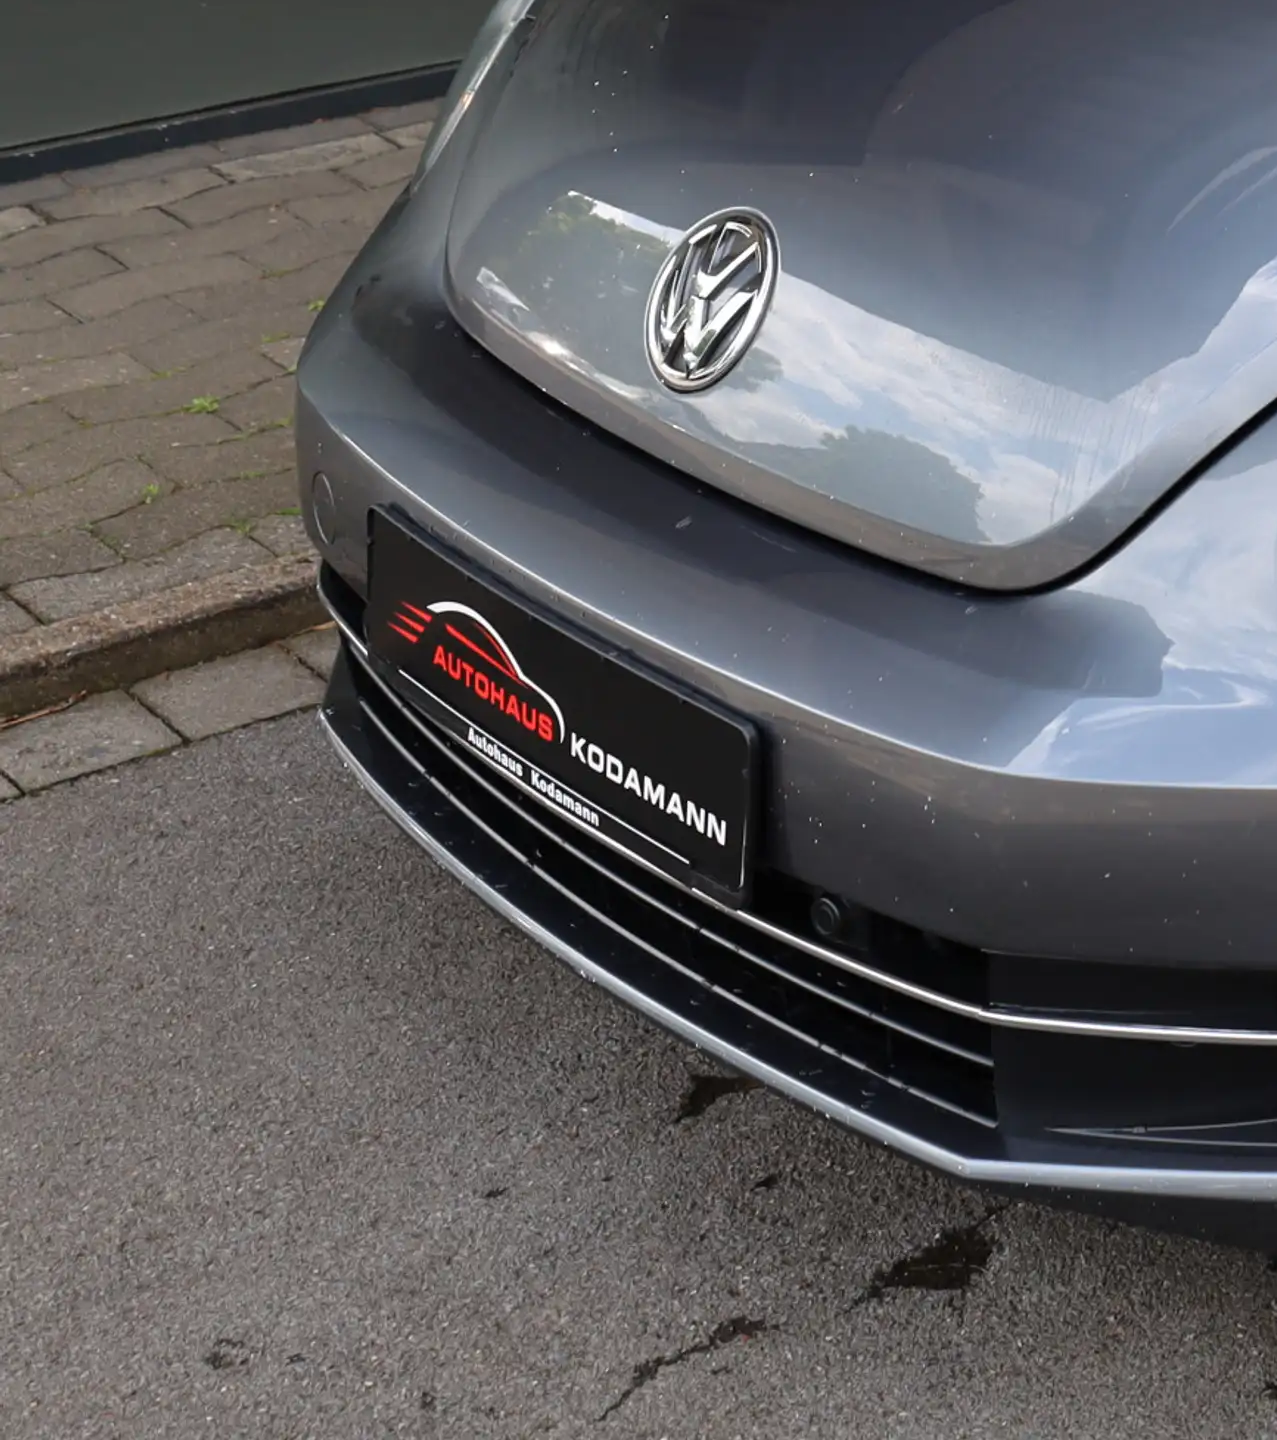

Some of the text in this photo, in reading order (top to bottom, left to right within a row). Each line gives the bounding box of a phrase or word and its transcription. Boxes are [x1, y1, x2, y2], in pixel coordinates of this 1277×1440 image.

[644, 206, 780, 394] VW
[432, 644, 728, 847] AUTOHAUS KODAMANN
[467, 726, 600, 827] Autohaus Kodamann
